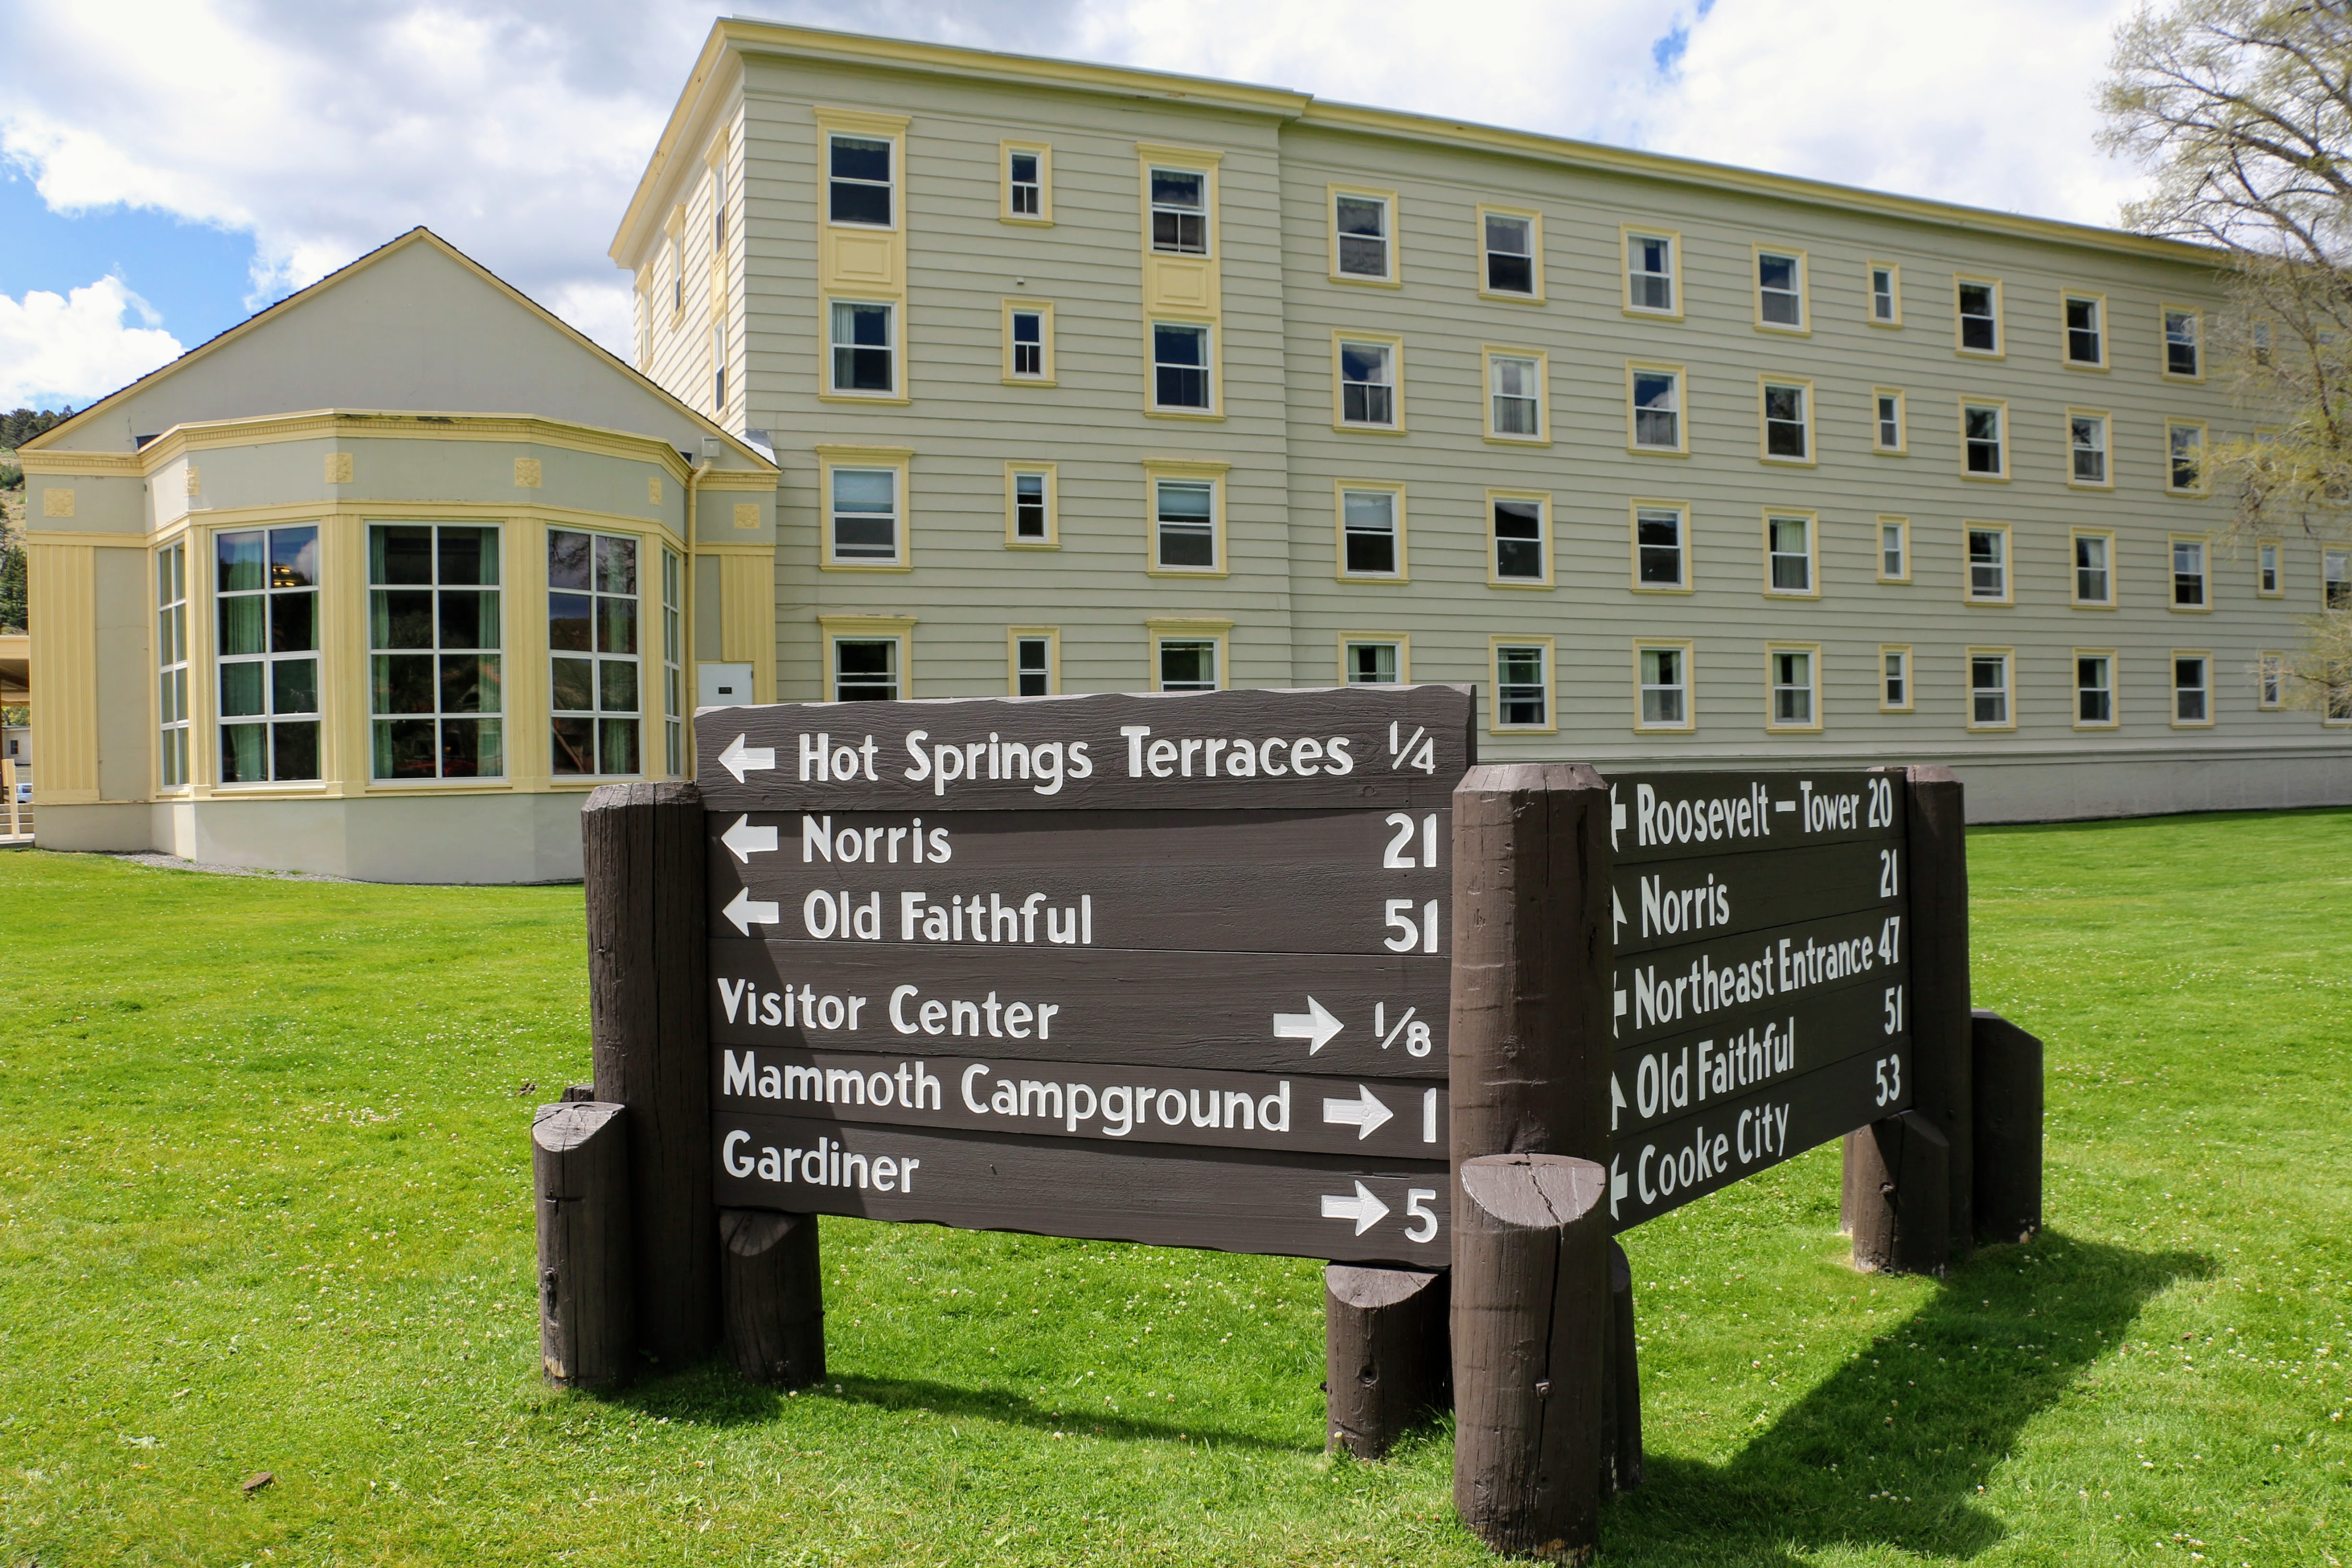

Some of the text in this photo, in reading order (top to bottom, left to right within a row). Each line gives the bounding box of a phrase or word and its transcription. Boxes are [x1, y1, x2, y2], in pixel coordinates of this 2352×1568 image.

[800, 733, 878, 781] Hot
[904, 730, 1092, 795] Springs
[1120, 726, 1353, 777] Terraces
[1869, 778, 1892, 827] 20
[803, 813, 1436, 868] Norris 21
[803, 889, 1438, 953] Old Faithful 51
[1641, 850, 1897, 937] Norris 21
[717, 978, 866, 1030] Visitor
[889, 985, 1059, 1039] Center
[1636, 916, 1900, 1029] Northeast Entrance 47
[1637, 985, 1902, 1118] Old Faithful 51
[724, 1050, 1436, 1143] Mammoth Campground 1
[1638, 1054, 1900, 1204] Cooke City 53
[723, 1130, 1438, 1243] Gardiner 5
